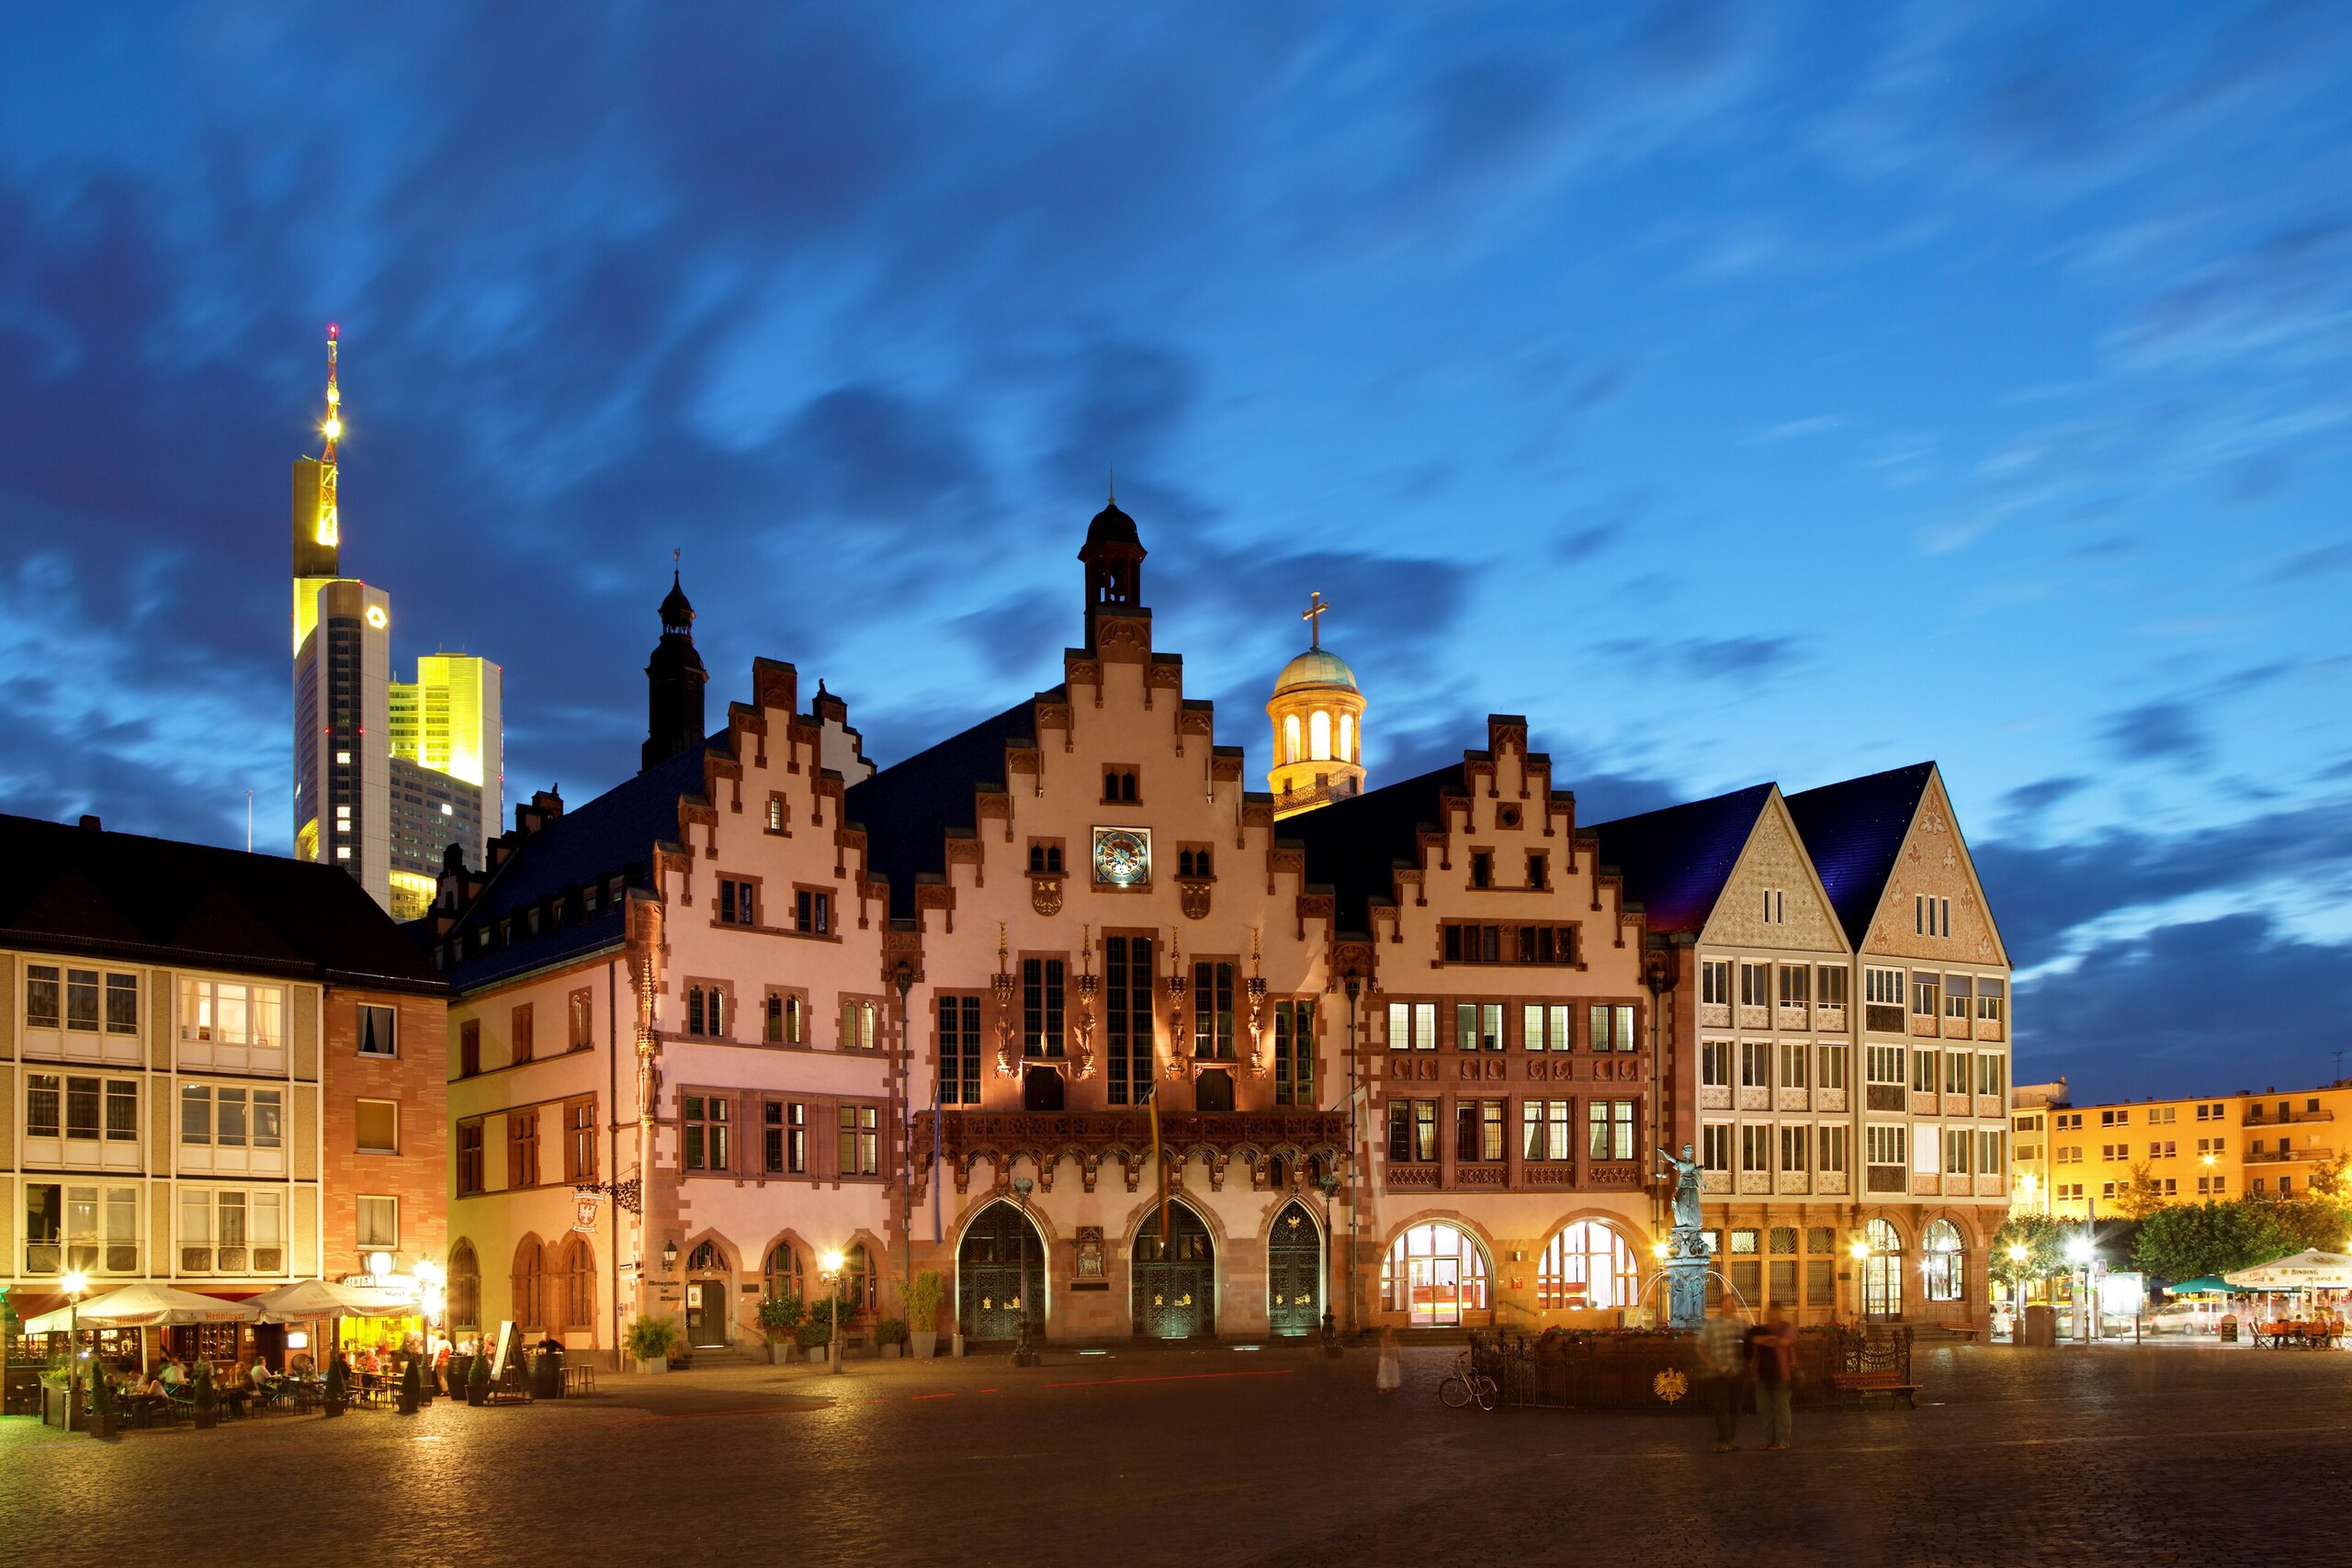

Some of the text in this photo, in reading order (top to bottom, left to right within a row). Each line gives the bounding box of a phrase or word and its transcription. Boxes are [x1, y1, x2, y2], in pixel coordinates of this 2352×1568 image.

[344, 1274, 376, 1287] ALTEN
[116, 1314, 157, 1325] Henninger
[206, 1312, 245, 1320] Henninger
[293, 1311, 331, 1321] Henninger
